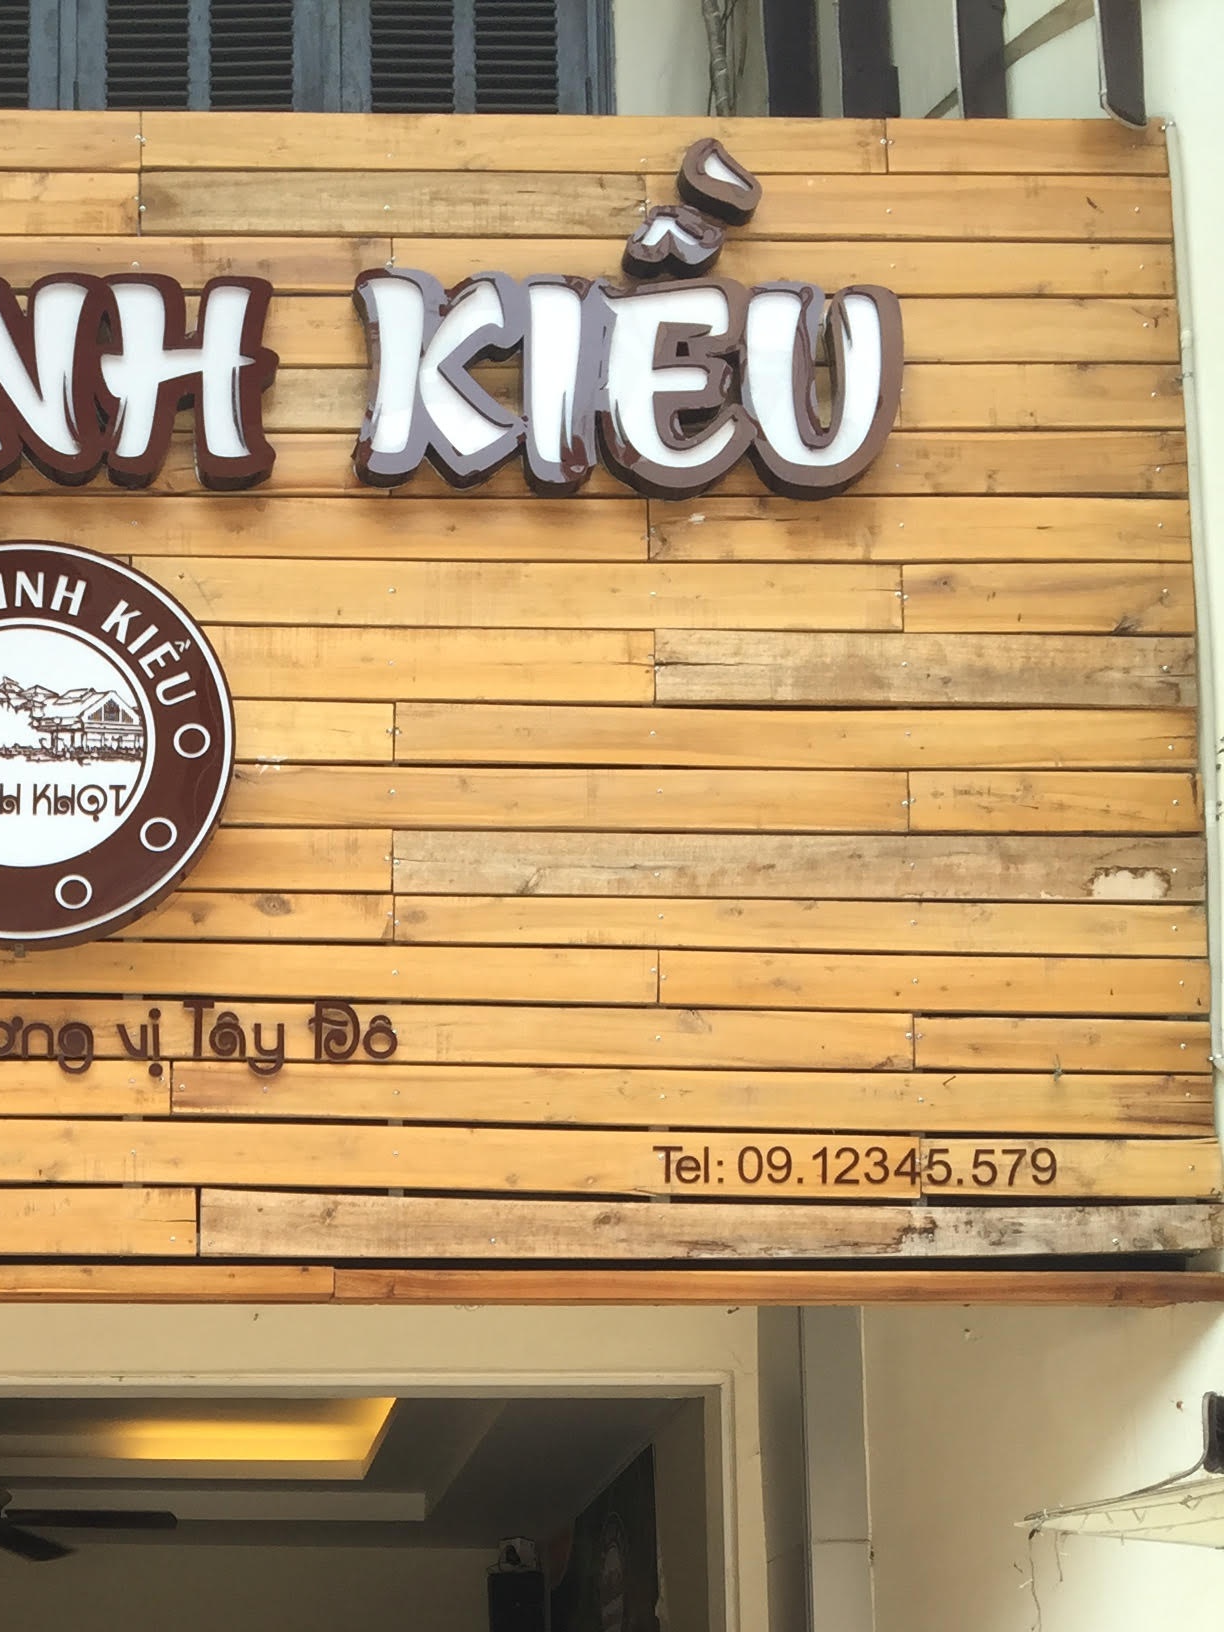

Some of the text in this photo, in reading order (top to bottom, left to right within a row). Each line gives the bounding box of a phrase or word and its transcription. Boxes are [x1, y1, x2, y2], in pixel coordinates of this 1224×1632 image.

[354, 137, 904, 501] KIỀU
[100, 600, 197, 707] KIỀU
[31, 783, 128, 822] KHỌT
[116, 1007, 164, 1077] vị
[182, 1000, 286, 1075] Tây
[308, 1000, 398, 1062] Đô
[651, 1144, 1058, 1187] Tel: 09.12345.579
